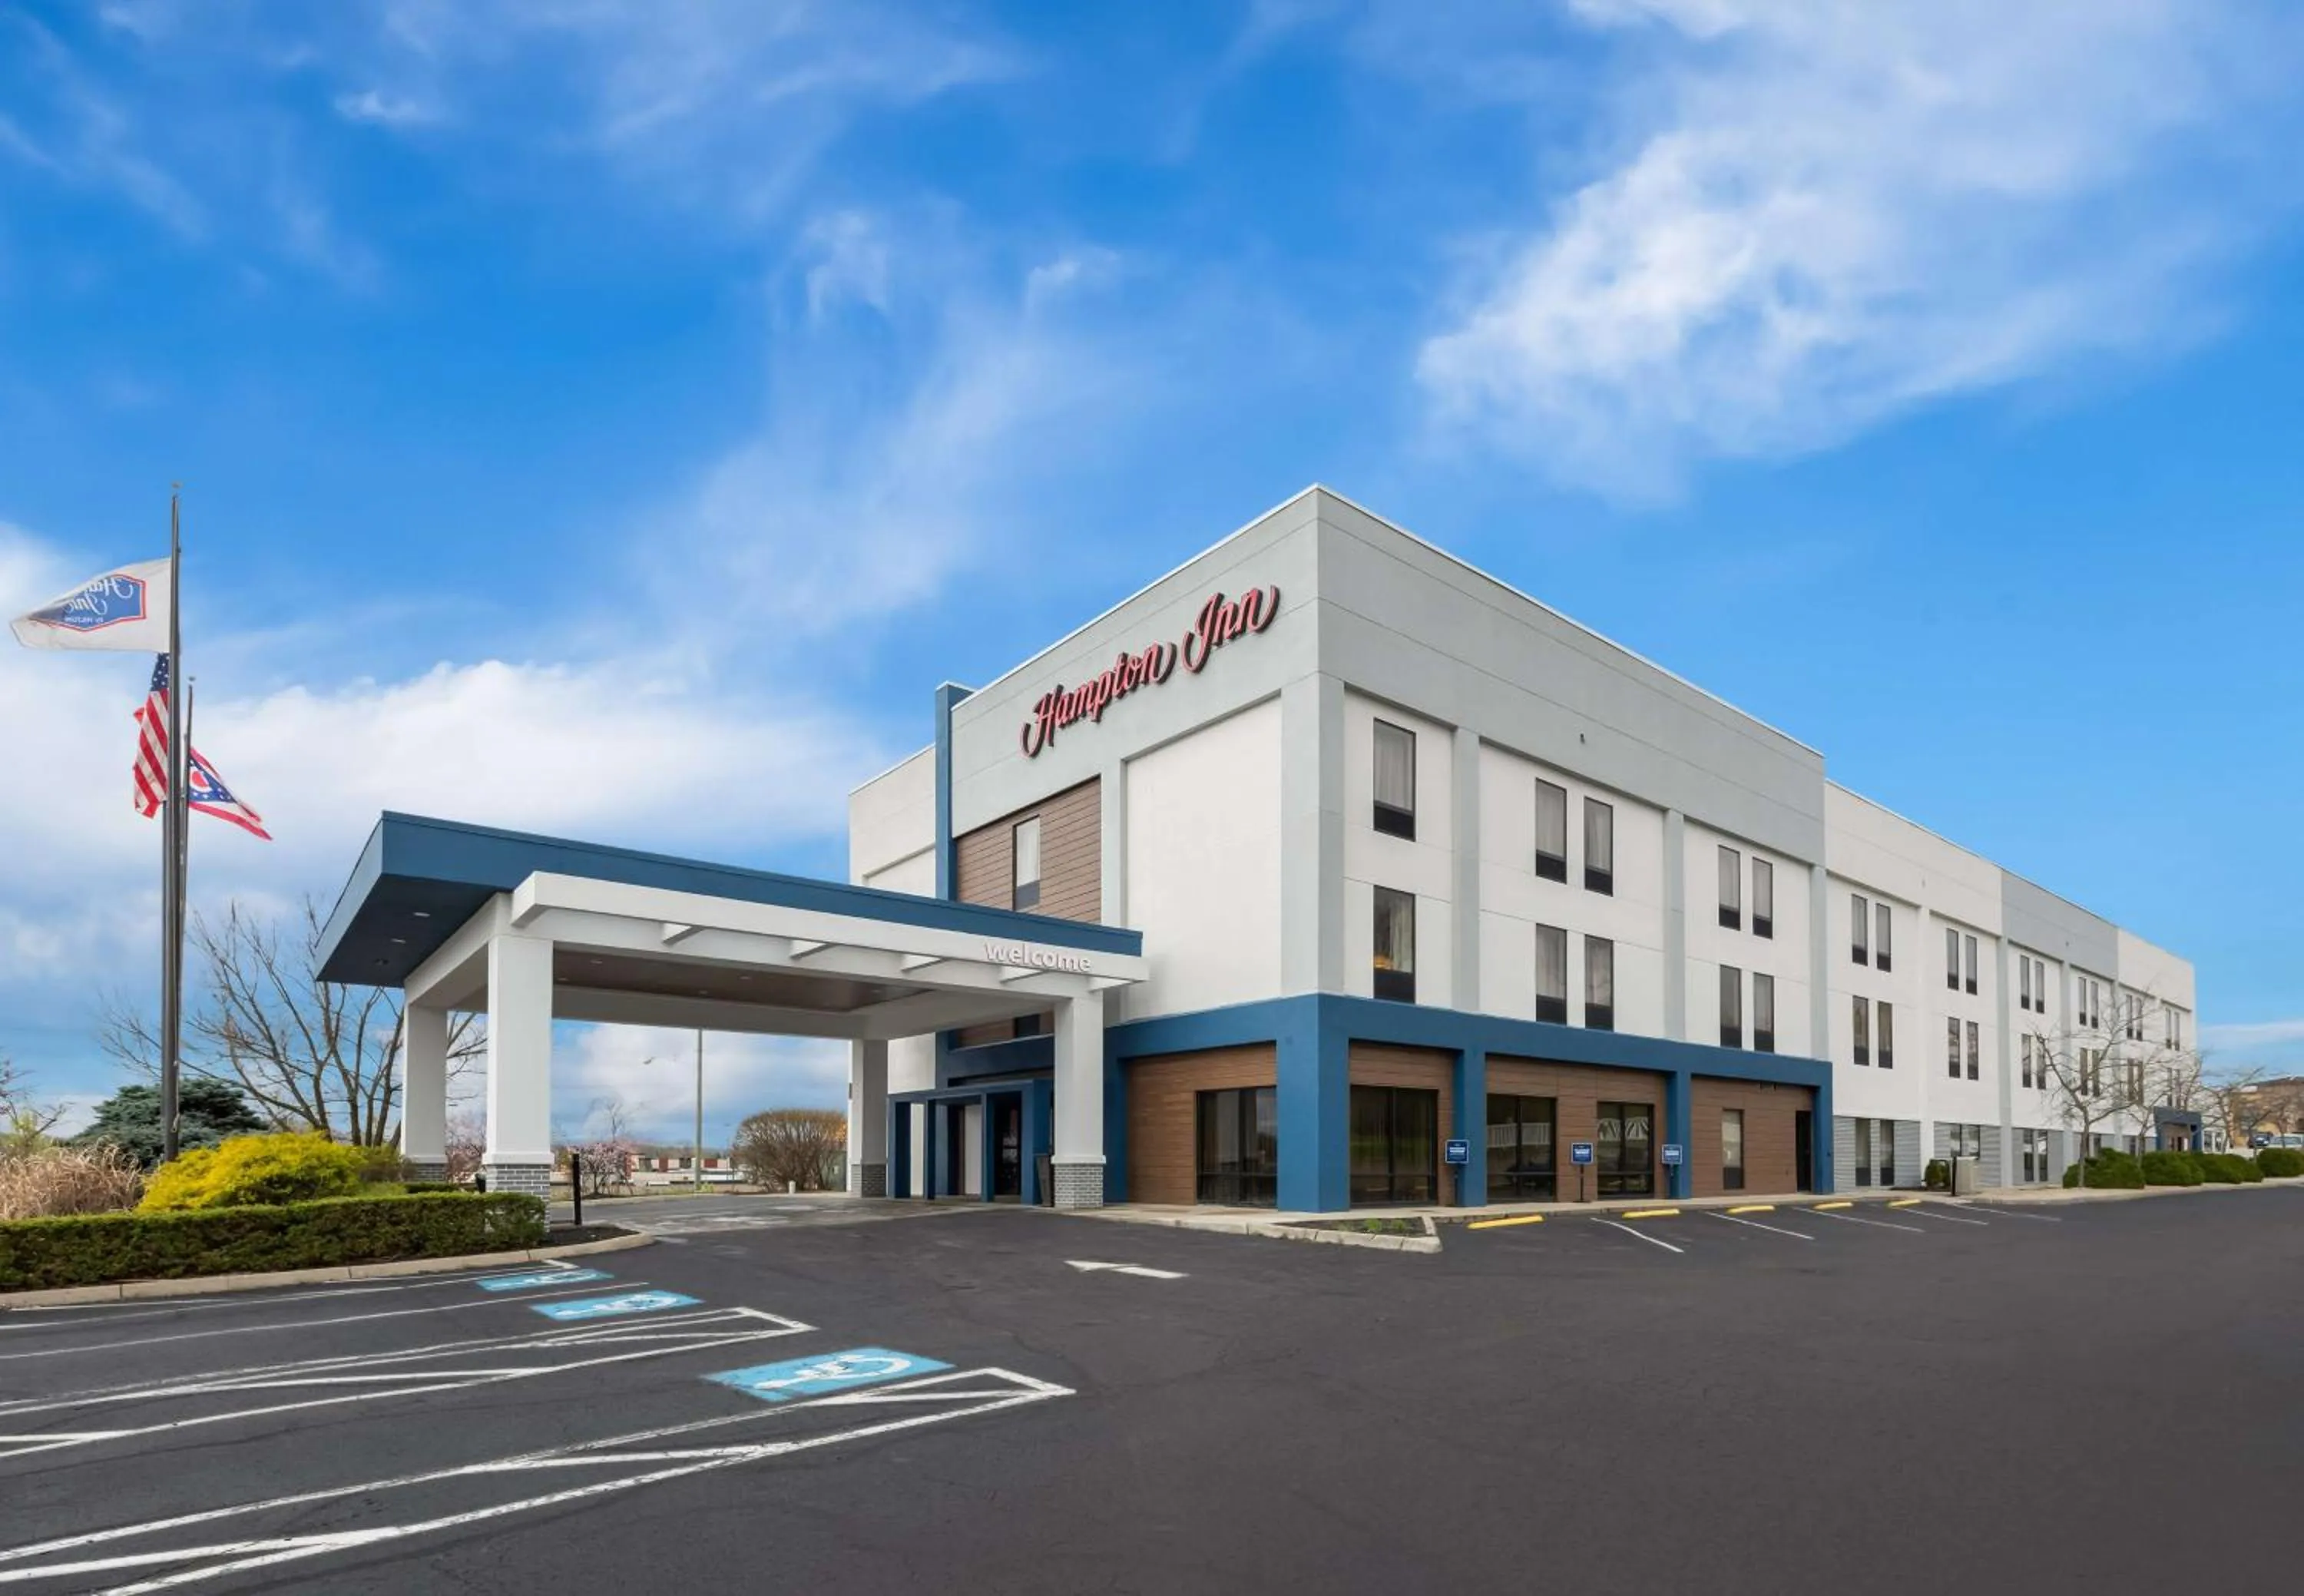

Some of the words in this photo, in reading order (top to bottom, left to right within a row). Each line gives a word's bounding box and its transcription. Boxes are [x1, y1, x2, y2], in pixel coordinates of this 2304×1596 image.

[1020, 642, 1177, 758] Hampton
[1181, 584, 1280, 674] Inn
[984, 940, 1092, 972] welcome
